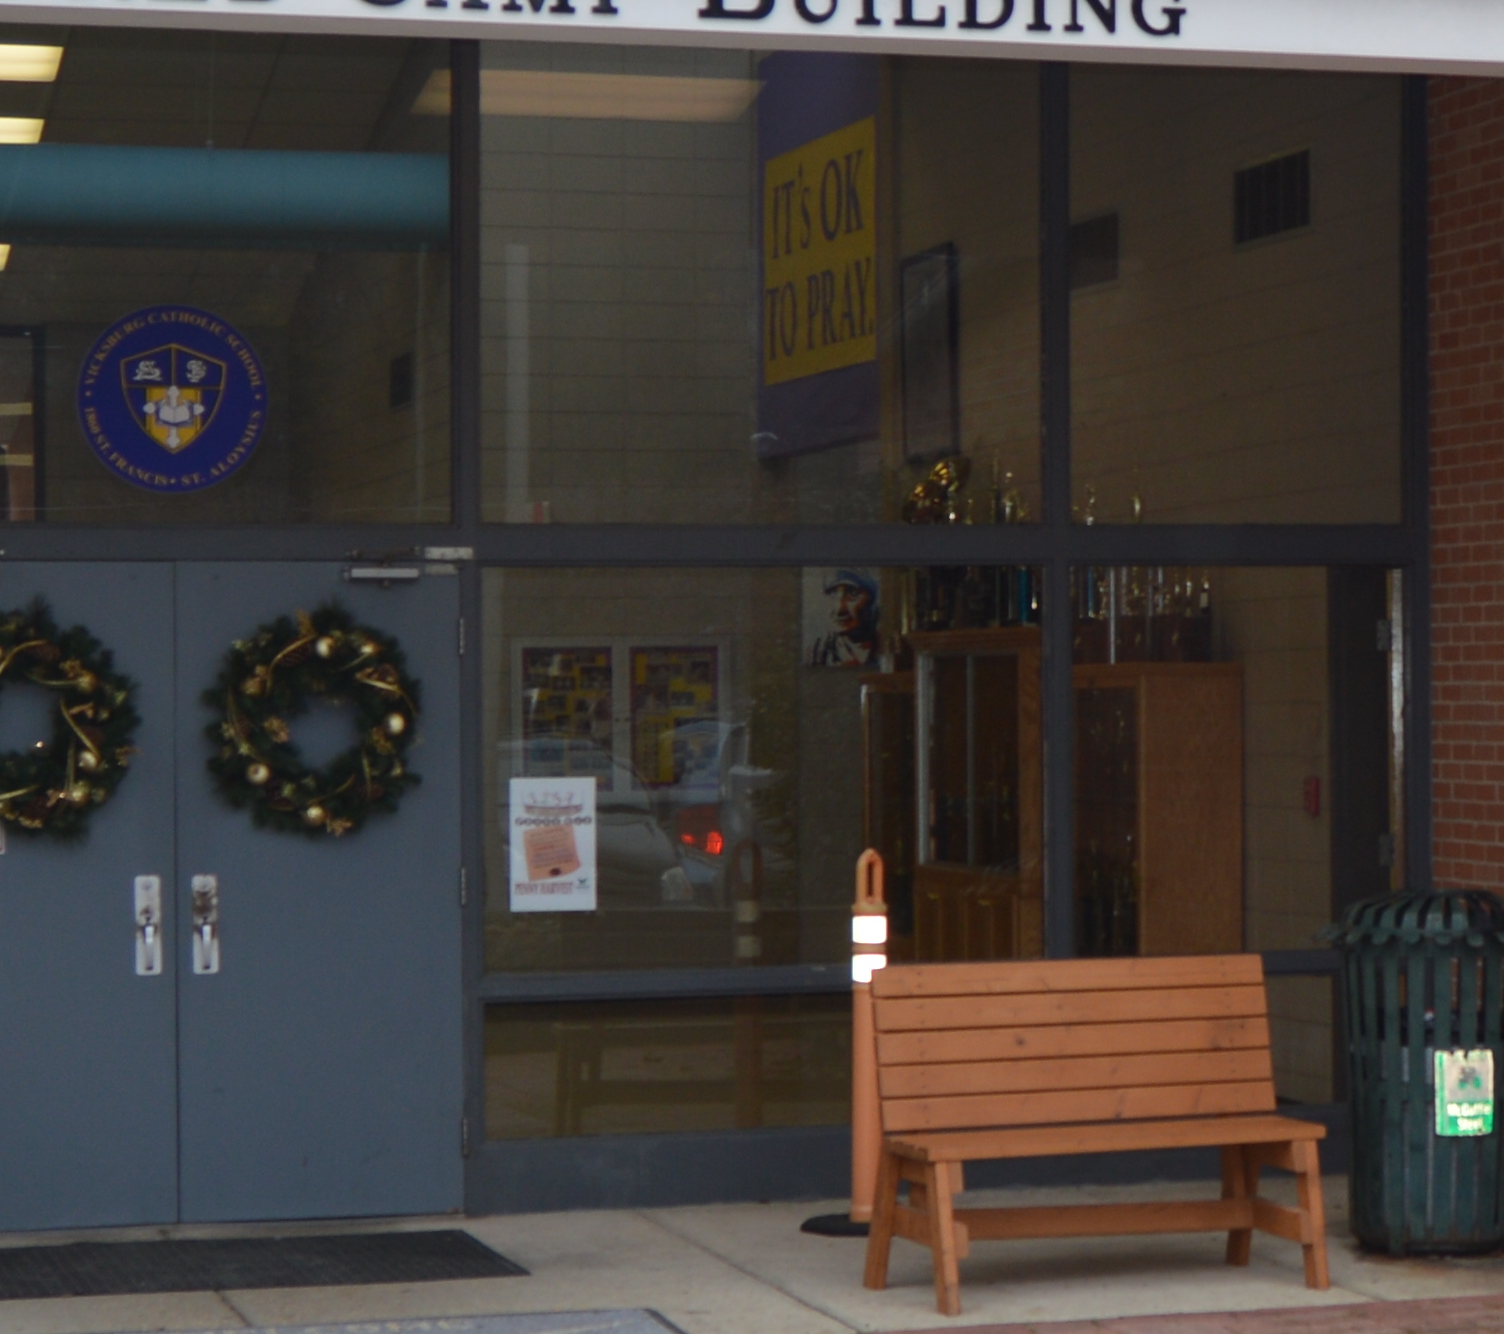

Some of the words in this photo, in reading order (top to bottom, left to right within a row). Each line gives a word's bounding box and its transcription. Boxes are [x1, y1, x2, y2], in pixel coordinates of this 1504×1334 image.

[819, 148, 865, 242] OK
[84, 318, 144, 384] VICKSBURG
[147, 311, 226, 336] CATHOLIC
[766, 281, 797, 361] TO
[108, 451, 168, 486] FRANCIS
[210, 410, 262, 476] ALOYSIUS
